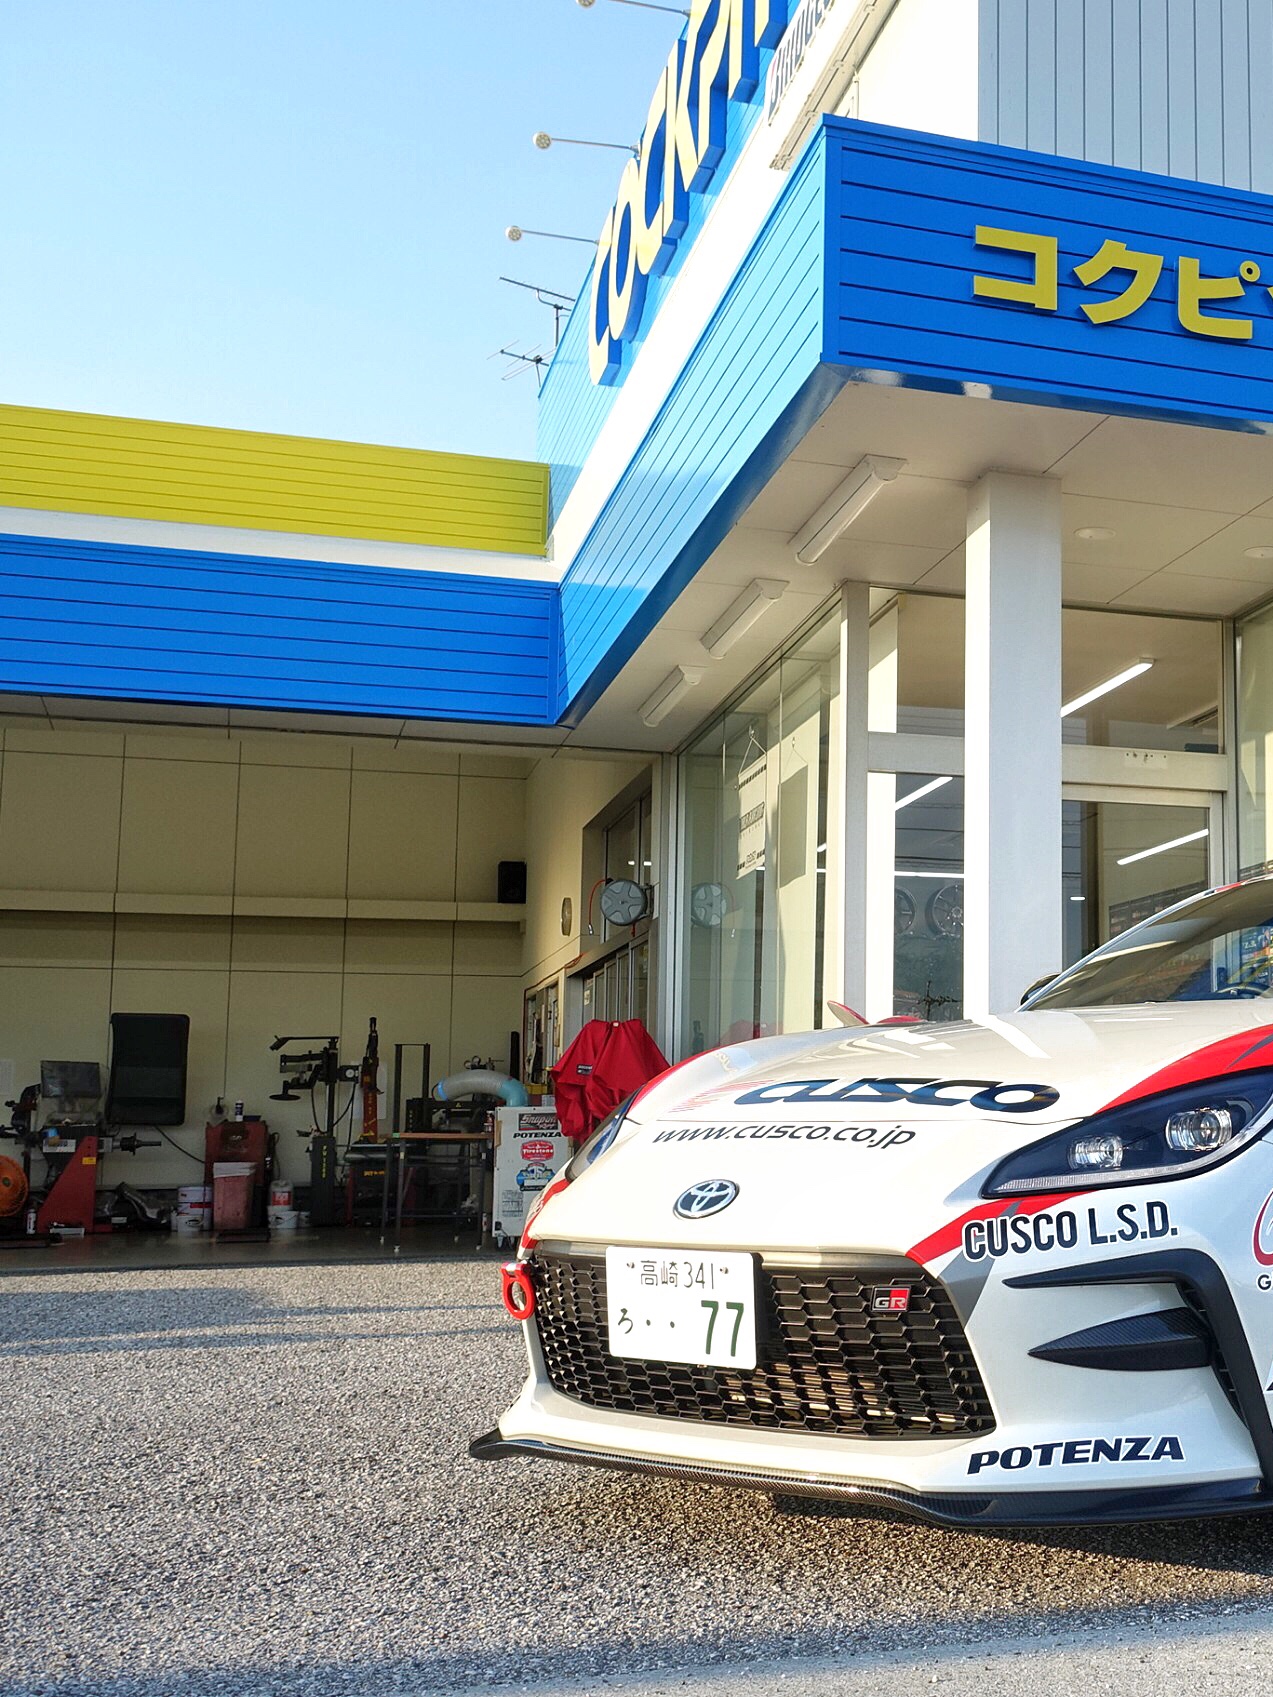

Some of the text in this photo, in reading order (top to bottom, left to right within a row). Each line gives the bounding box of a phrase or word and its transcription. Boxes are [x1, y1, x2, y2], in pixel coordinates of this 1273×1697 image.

[652, 1124, 917, 1150] www.cusco.co.jp
[964, 1200, 1178, 1260] CUSCO L.S.D.
[641, 1260, 714, 1290] 高崎 341
[874, 1296, 906, 1308] GR
[966, 1436, 1186, 1475] POTENZA
